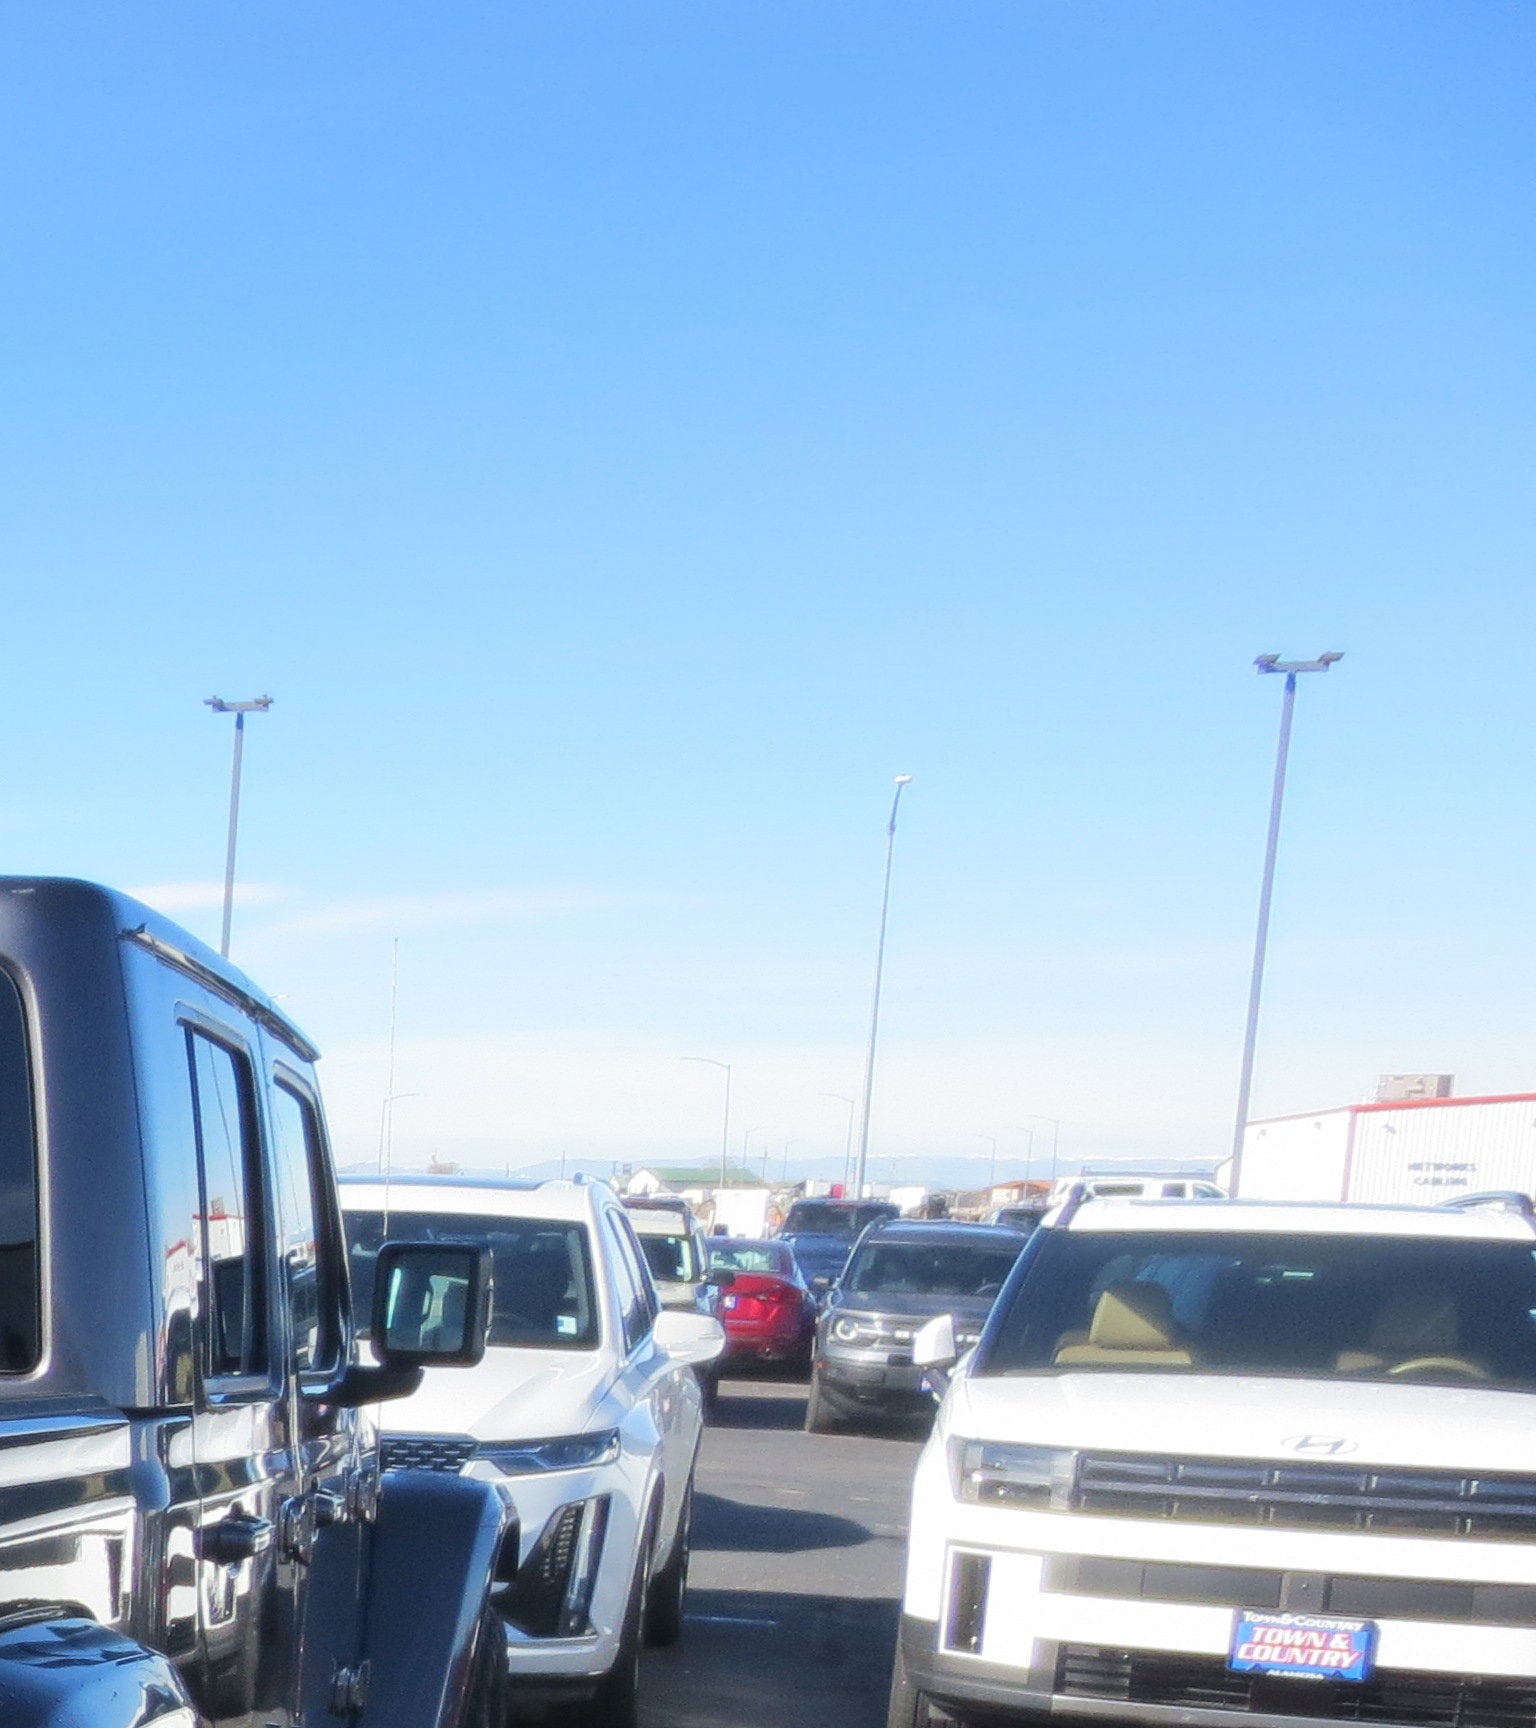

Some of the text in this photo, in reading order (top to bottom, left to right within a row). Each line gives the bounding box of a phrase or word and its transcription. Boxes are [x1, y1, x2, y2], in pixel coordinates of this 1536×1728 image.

[1252, 1626, 1350, 1649] TOWN &
[1238, 1643, 1361, 1668] COUNTRY
